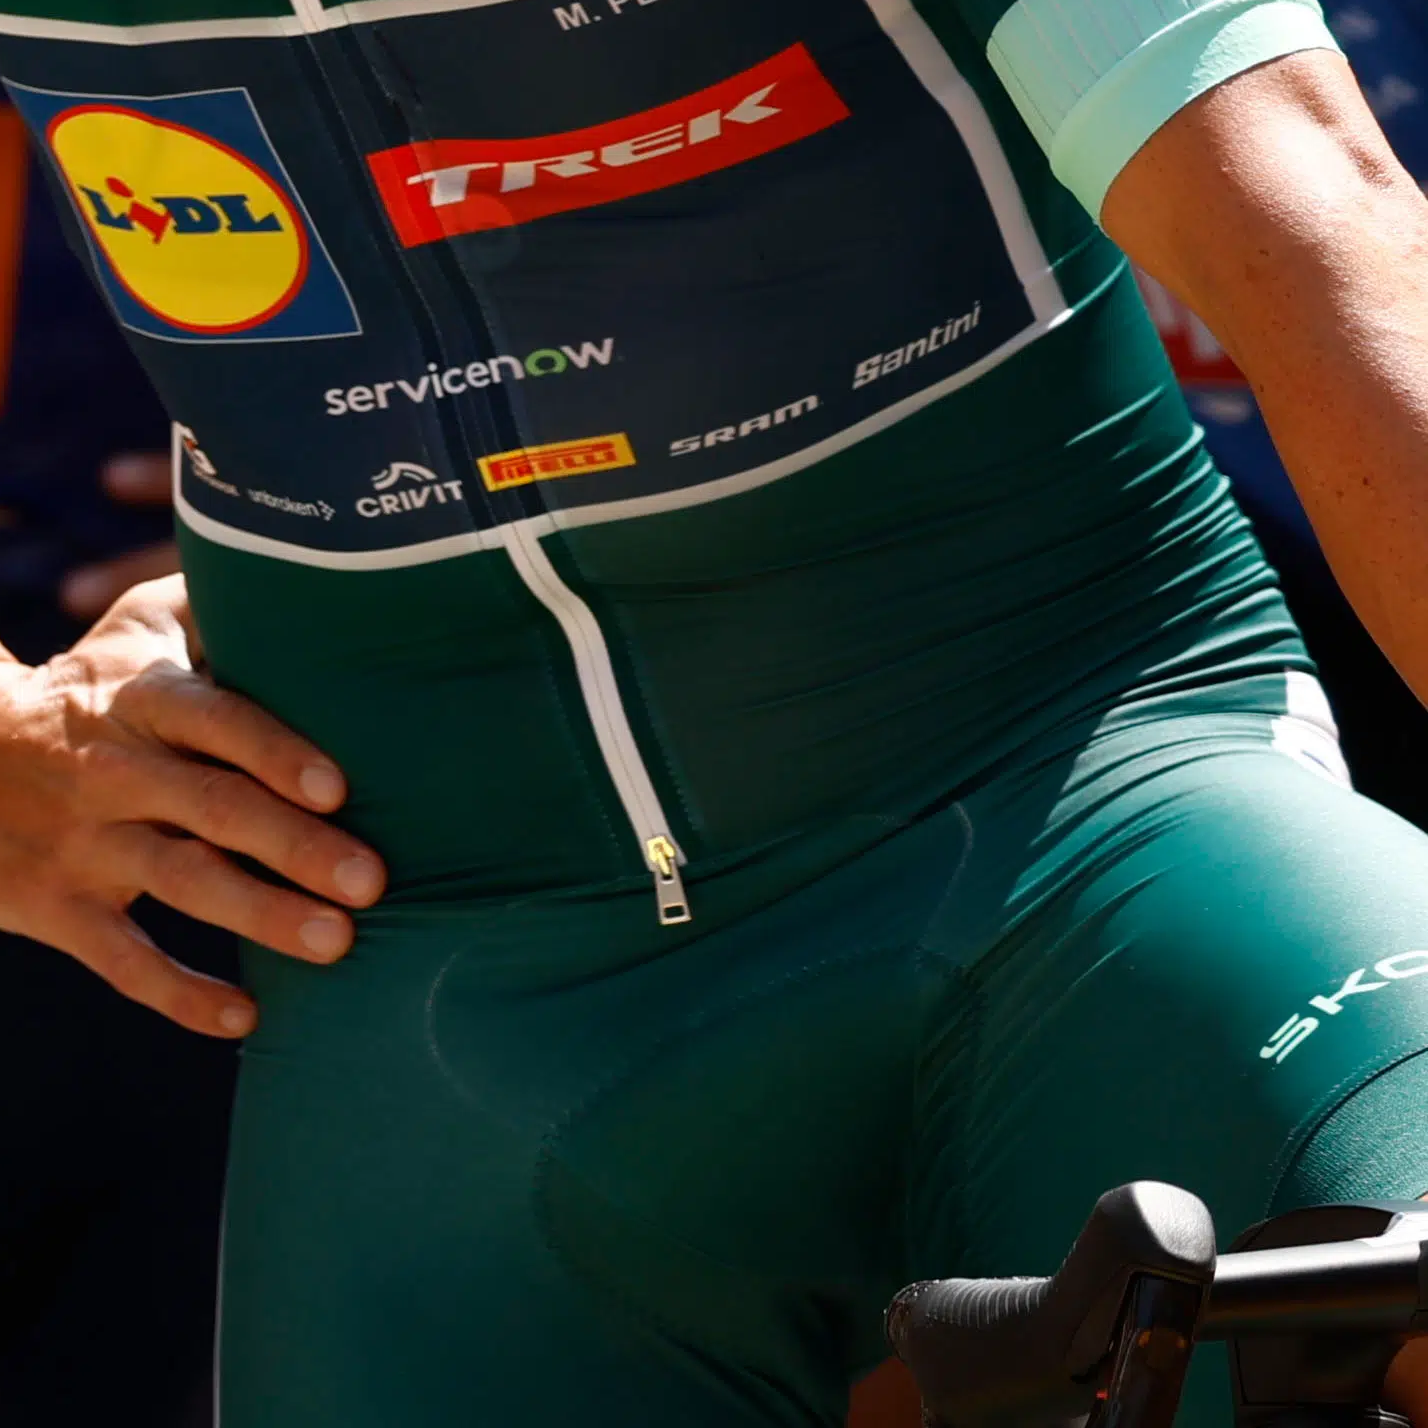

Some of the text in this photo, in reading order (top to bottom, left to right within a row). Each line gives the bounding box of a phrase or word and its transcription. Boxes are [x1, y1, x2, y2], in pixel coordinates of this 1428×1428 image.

[552, 1, 603, 32] M.
[406, 81, 784, 208] TREK
[323, 337, 616, 416] servicenow
[852, 300, 983, 391] Santini
[669, 394, 821, 457] SRAM
[354, 479, 464, 519] CRIVIT
